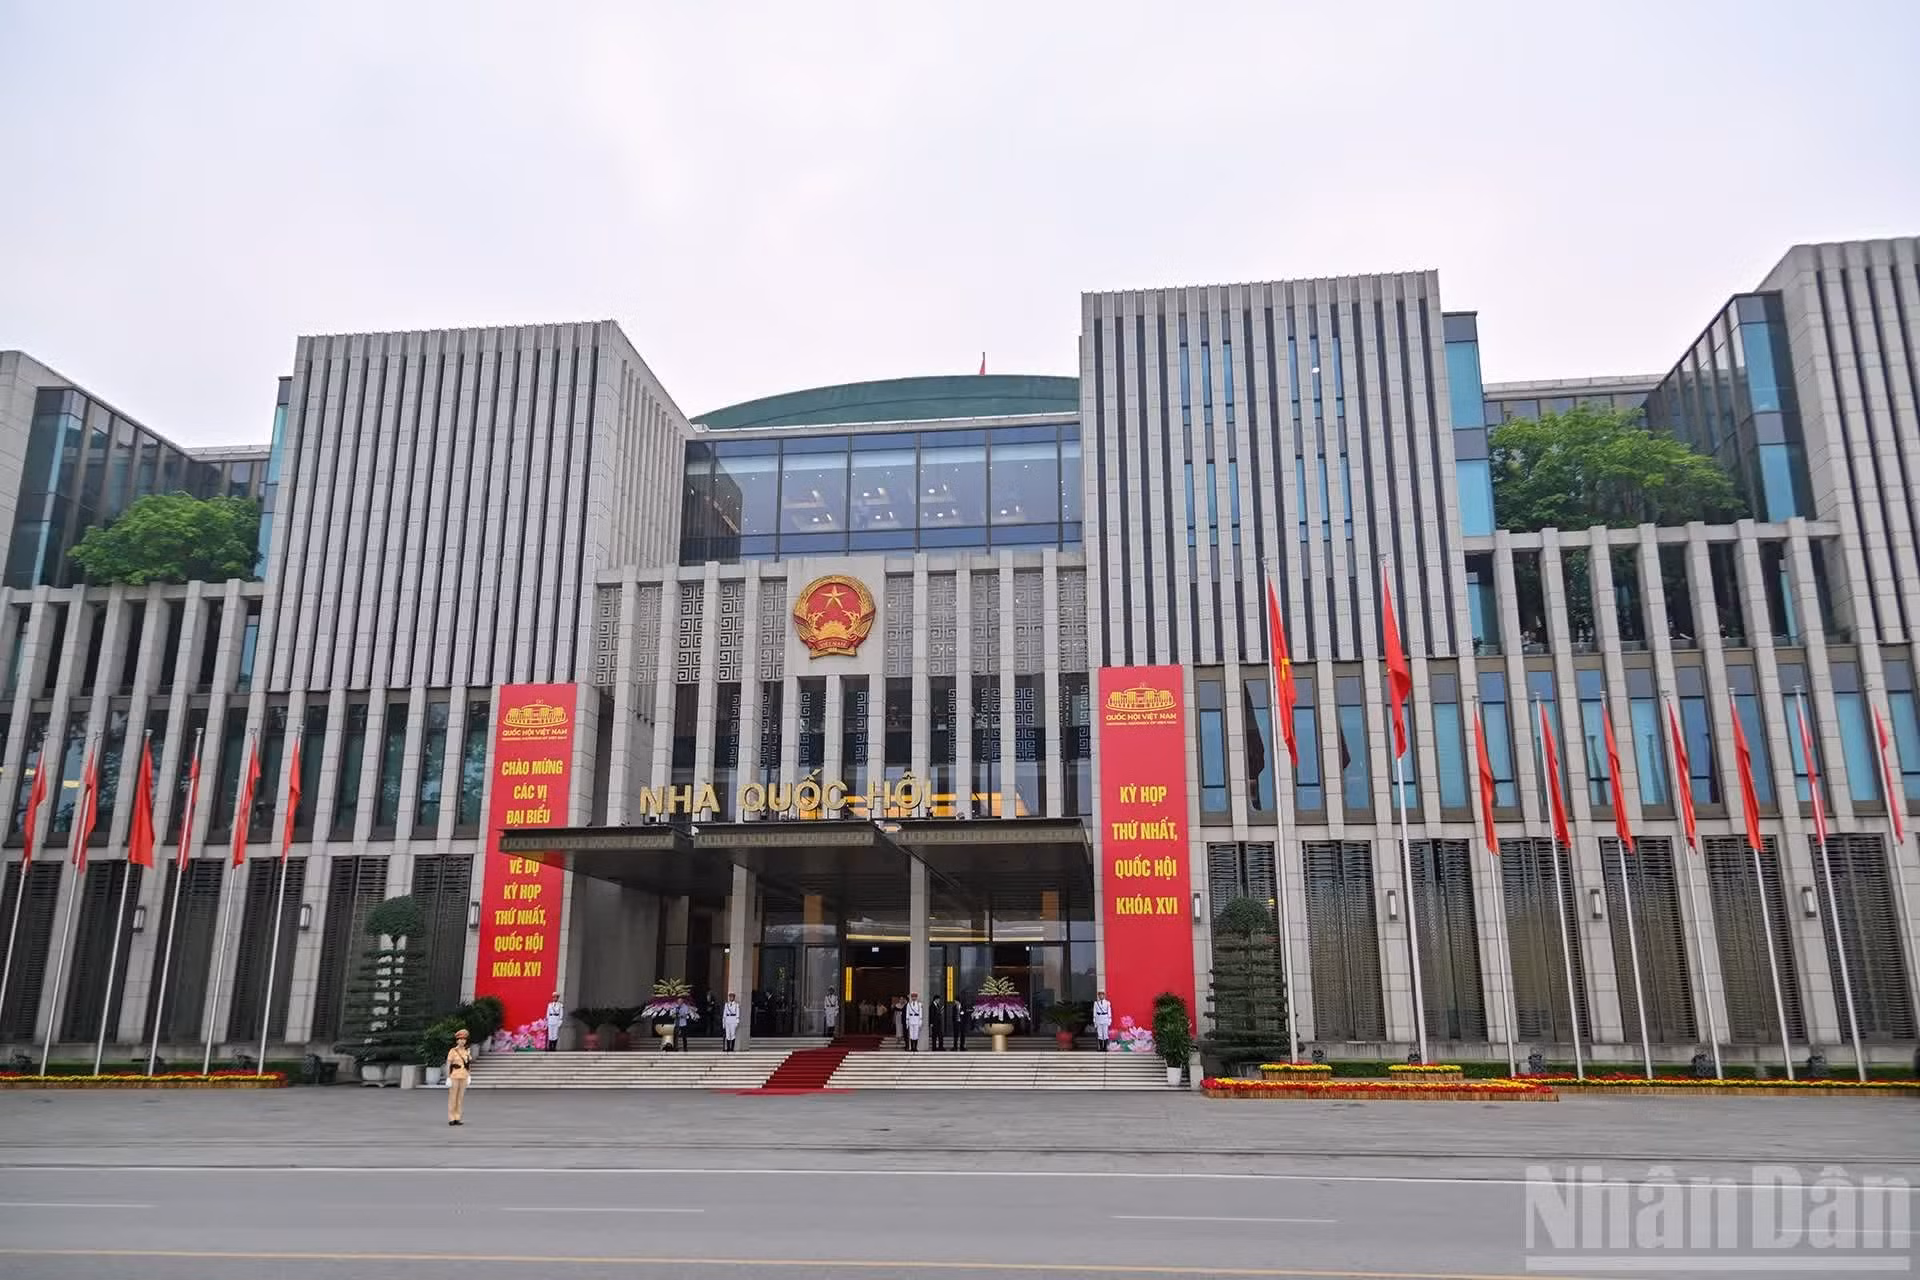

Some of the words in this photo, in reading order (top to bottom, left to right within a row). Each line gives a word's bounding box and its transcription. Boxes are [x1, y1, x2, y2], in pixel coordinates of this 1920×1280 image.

[502, 758, 529, 776] CHÀO
[532, 757, 563, 775] MỪNG
[513, 782, 535, 800] CÁC
[537, 784, 548, 802] VỊ
[640, 778, 720, 815] NHÀ
[739, 769, 848, 813] QUỐC
[1120, 783, 1137, 803] KỲ
[1140, 786, 1167, 806] HỌP
[506, 810, 524, 827] ĐẠI
[526, 803, 550, 824] BIỂU
[1111, 819, 1139, 840] THỨ
[1140, 816, 1178, 841] NHẤT,
[1115, 854, 1151, 879] QUỐC
[1154, 855, 1177, 880] HỘI
[520, 884, 542, 902] HỌP
[1116, 893, 1153, 915] KHÓA
[1155, 897, 1178, 915] XVI
[495, 906, 517, 925] THỨ
[517, 904, 546, 927] NHẤT,
[494, 930, 523, 952] QUỐC
[524, 933, 544, 954] HỘI
[492, 959, 521, 978] KHÓA
[523, 961, 542, 977] XVI
